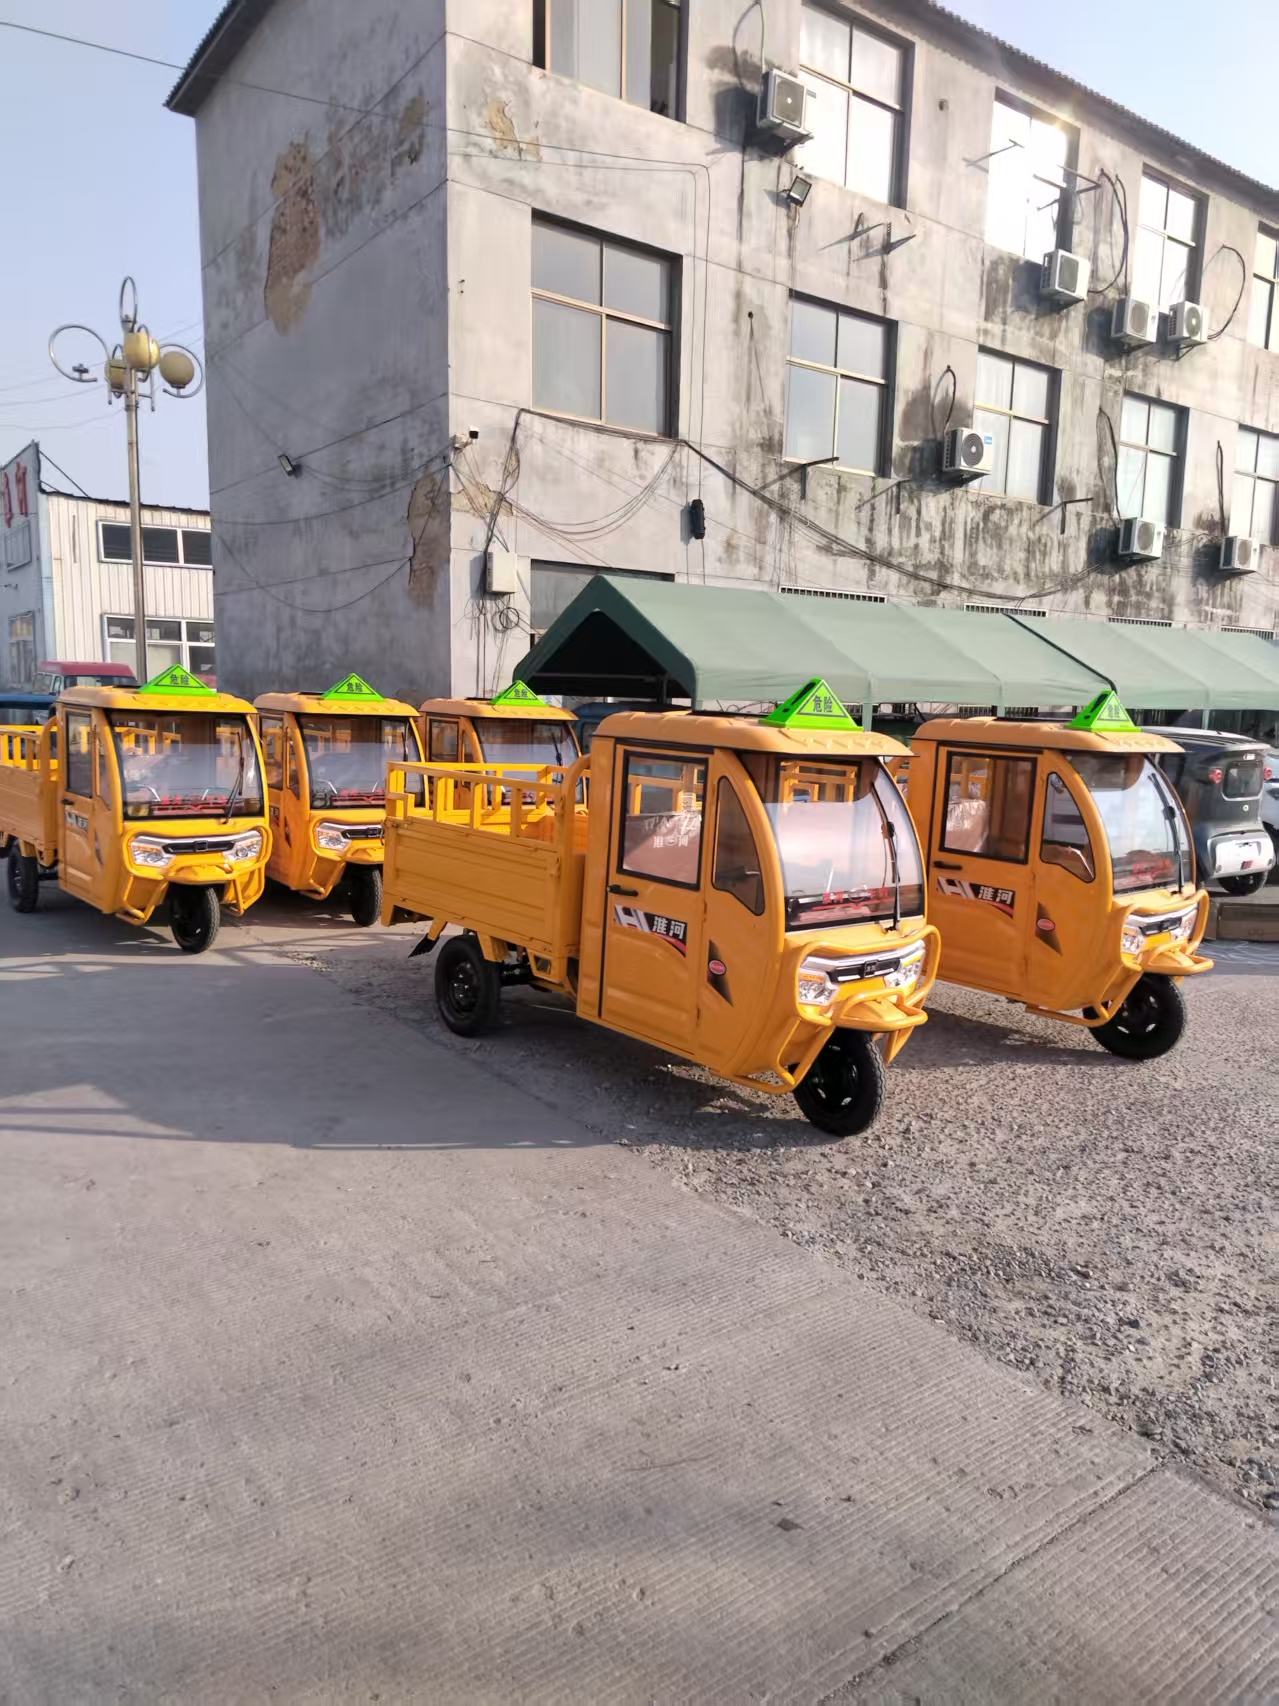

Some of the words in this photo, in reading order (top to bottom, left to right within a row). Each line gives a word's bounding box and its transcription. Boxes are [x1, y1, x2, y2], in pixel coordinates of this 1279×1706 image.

[170, 673, 190, 685] 危险
[813, 695, 833, 713] 危险
[977, 886, 1014, 905] 淮河
[652, 915, 686, 940] 淮河
